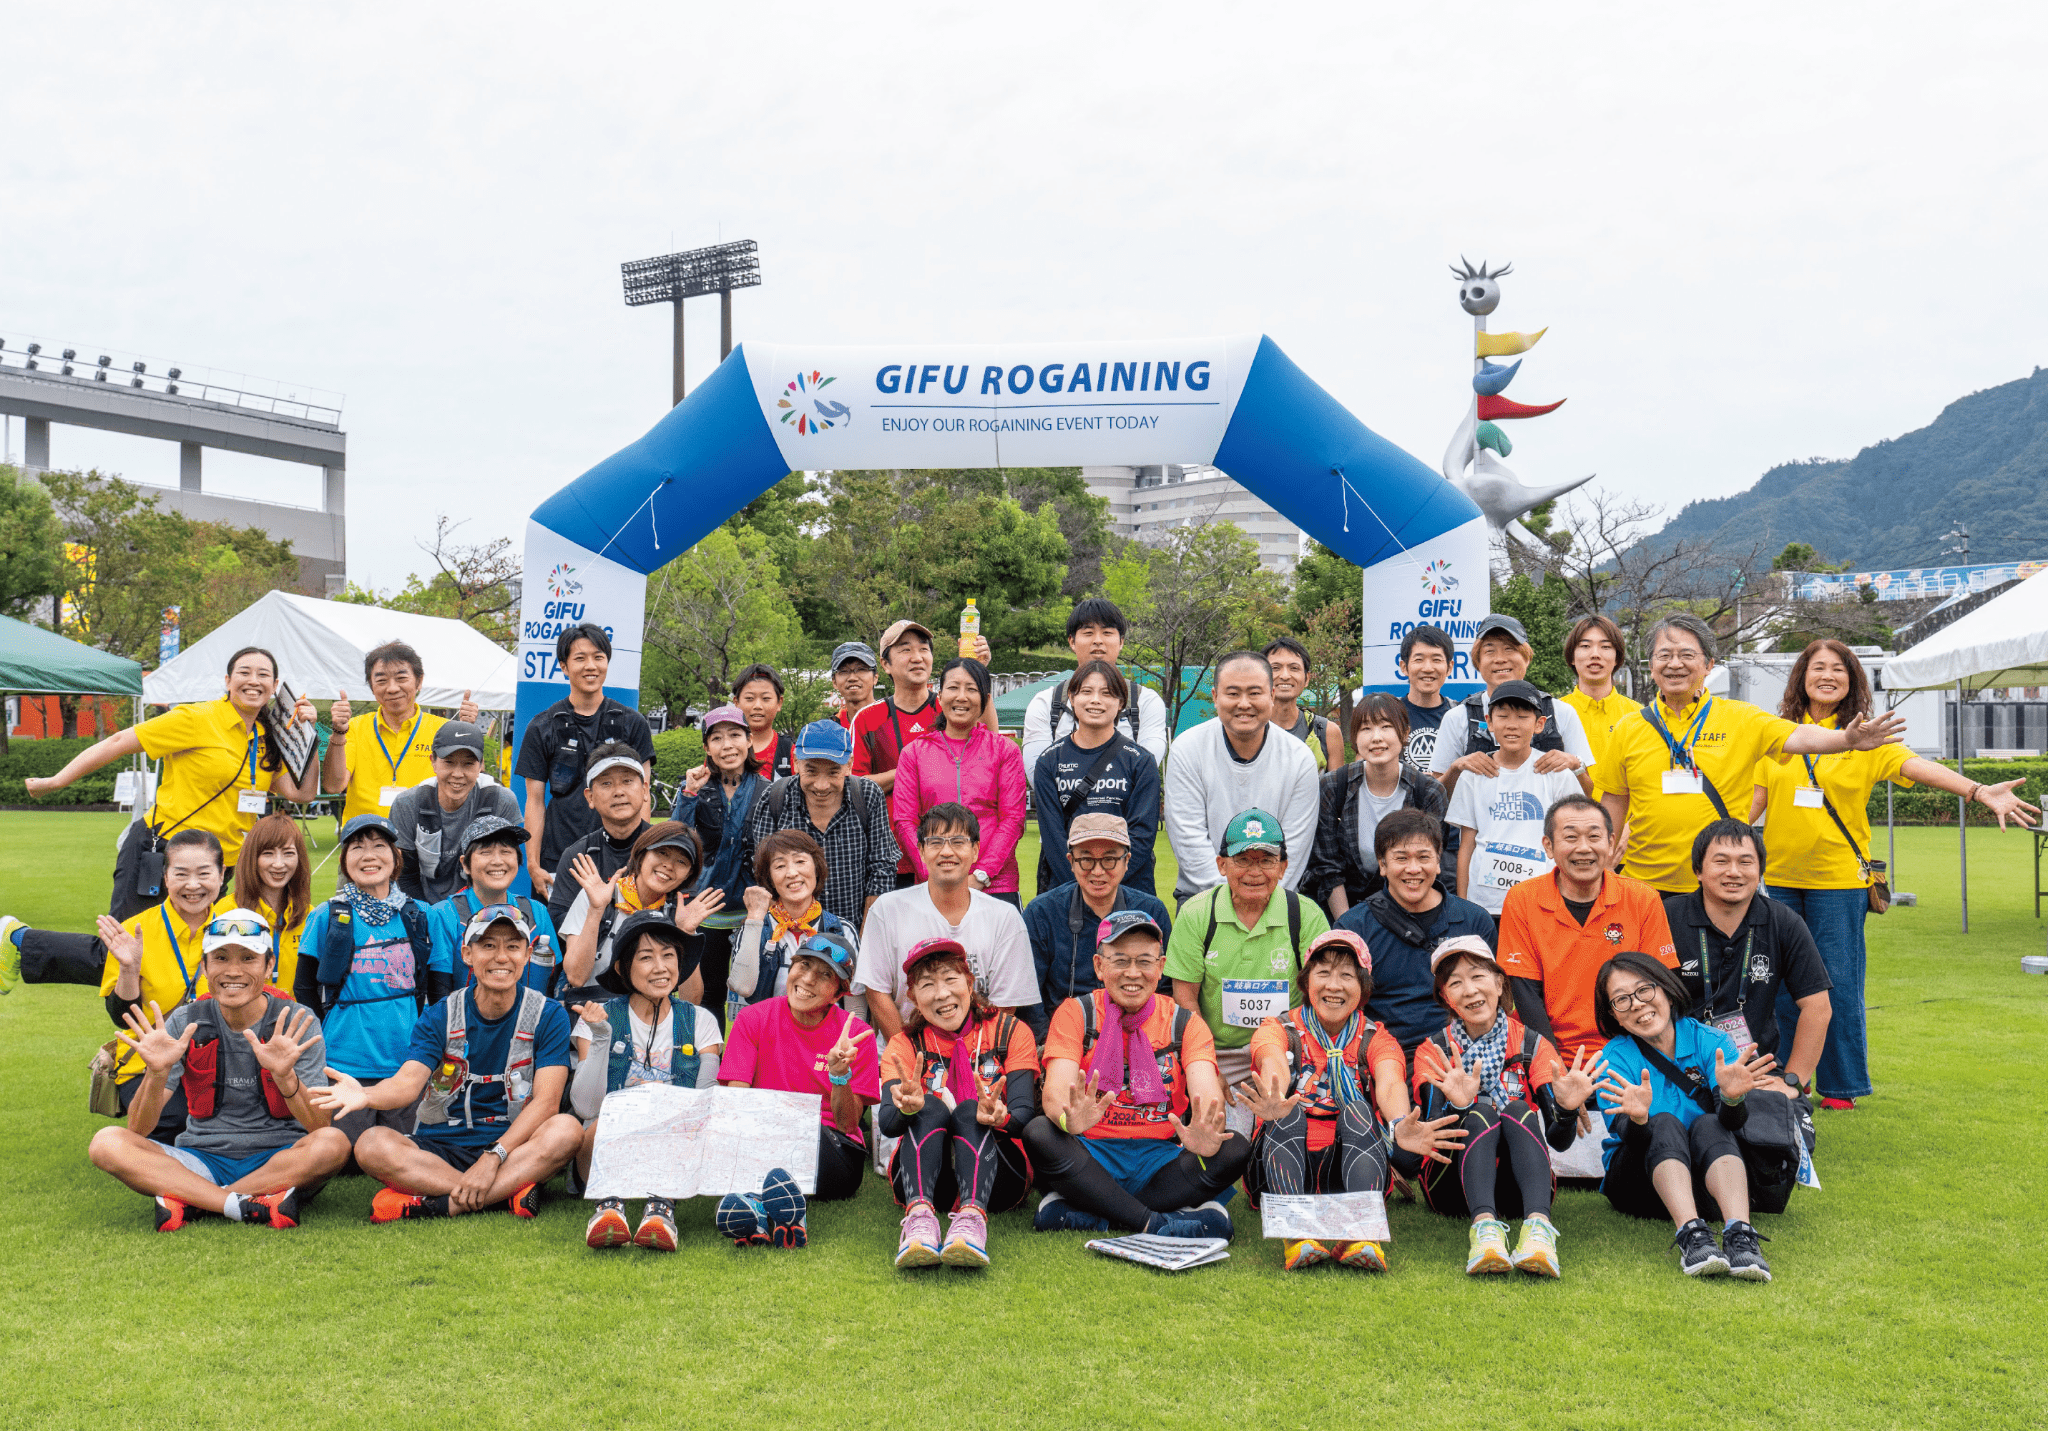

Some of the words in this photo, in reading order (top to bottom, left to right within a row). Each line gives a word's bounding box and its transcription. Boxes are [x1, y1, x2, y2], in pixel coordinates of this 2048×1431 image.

[875, 364, 970, 395] GIFU
[980, 361, 1211, 395] ROGAINING
[882, 417, 929, 432] ENJOY
[932, 417, 965, 432] OUR
[969, 417, 1053, 433] ROGAINING
[1056, 416, 1104, 431] EVENT
[1105, 415, 1159, 430] TODAY
[544, 601, 586, 621] GIFU
[1418, 599, 1462, 618] GIFU
[524, 651, 570, 681] STA
[1499, 791, 1521, 803] THE
[1493, 810, 1523, 821] FACE
[1492, 858, 1534, 876] 7008-2
[1239, 998, 1272, 1012] 5037
[1717, 1018, 1746, 1031] 2024
[1112, 1111, 1137, 1122] 2024
